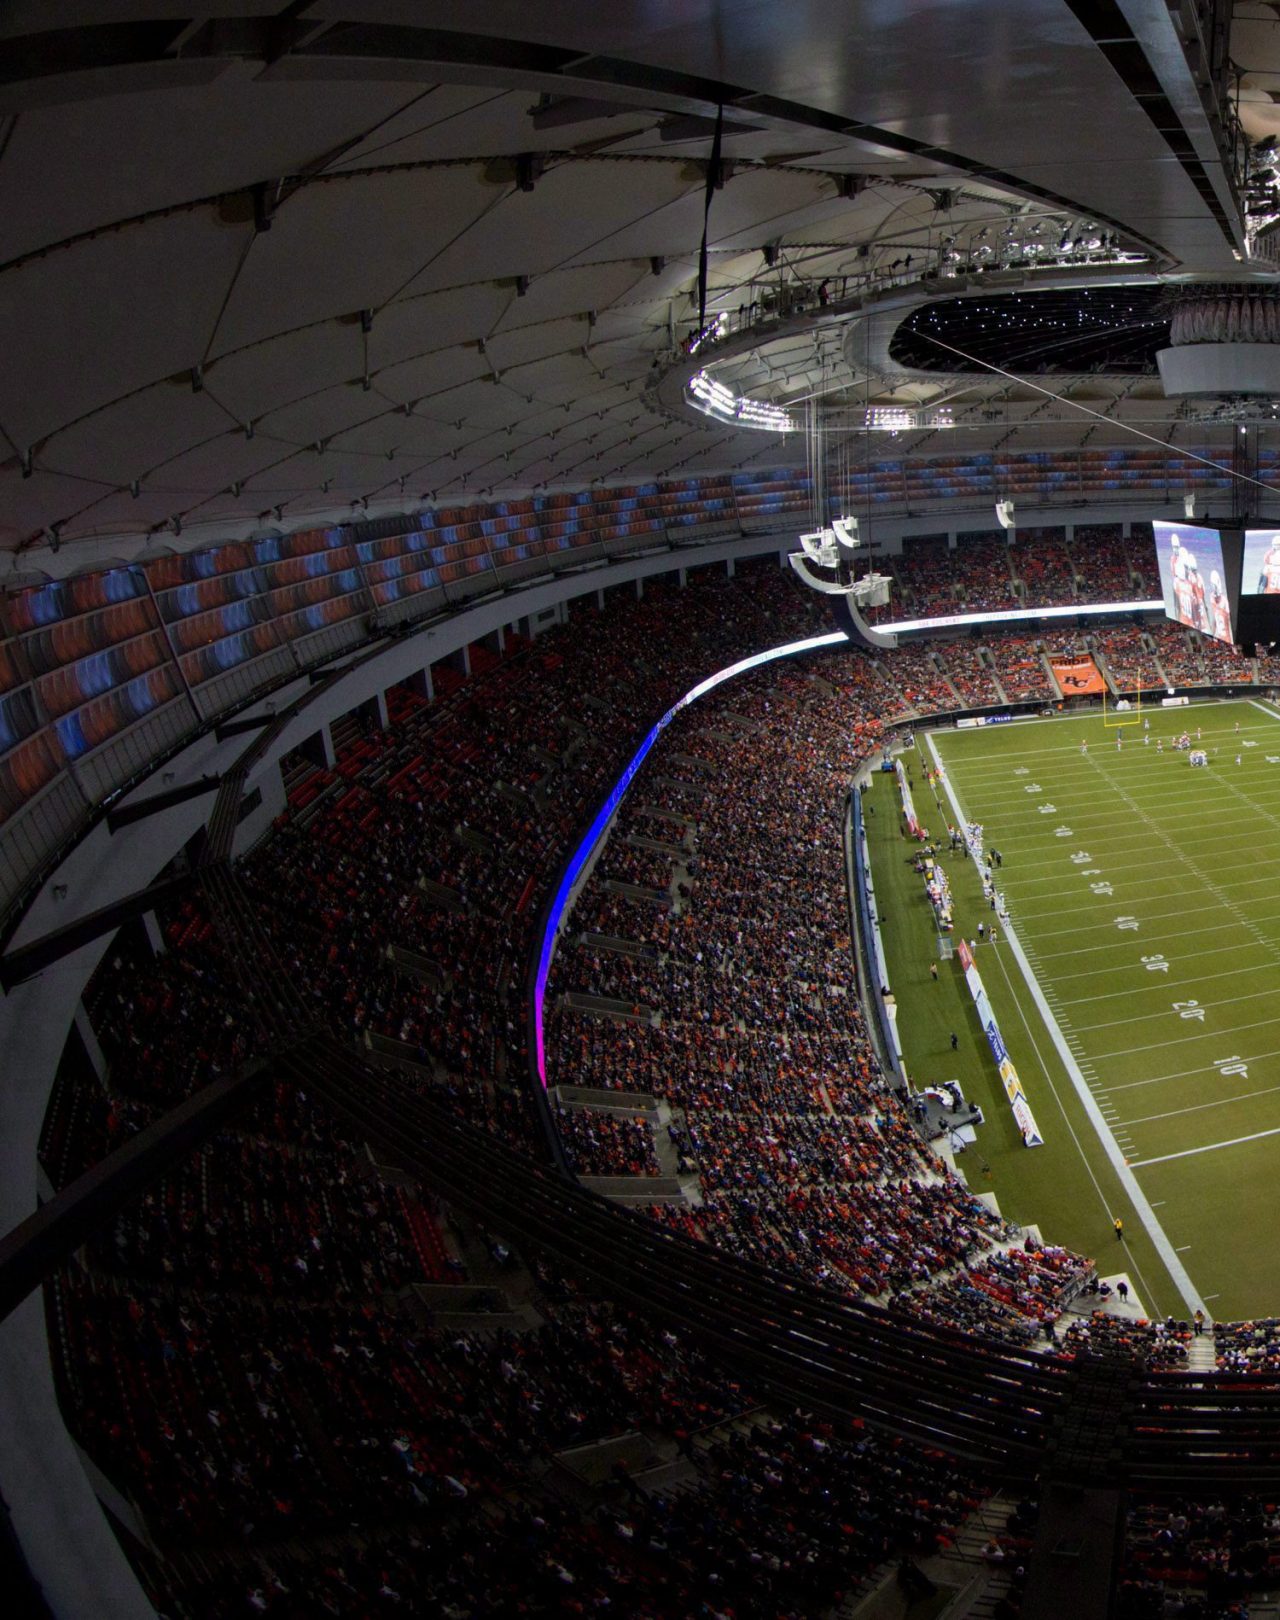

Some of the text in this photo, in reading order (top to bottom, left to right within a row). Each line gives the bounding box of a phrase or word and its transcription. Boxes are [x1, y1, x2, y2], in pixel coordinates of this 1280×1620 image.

[1140, 954, 1169, 971] 30
[1172, 1000, 1205, 1019] 20
[1213, 1056, 1248, 1076] 10
